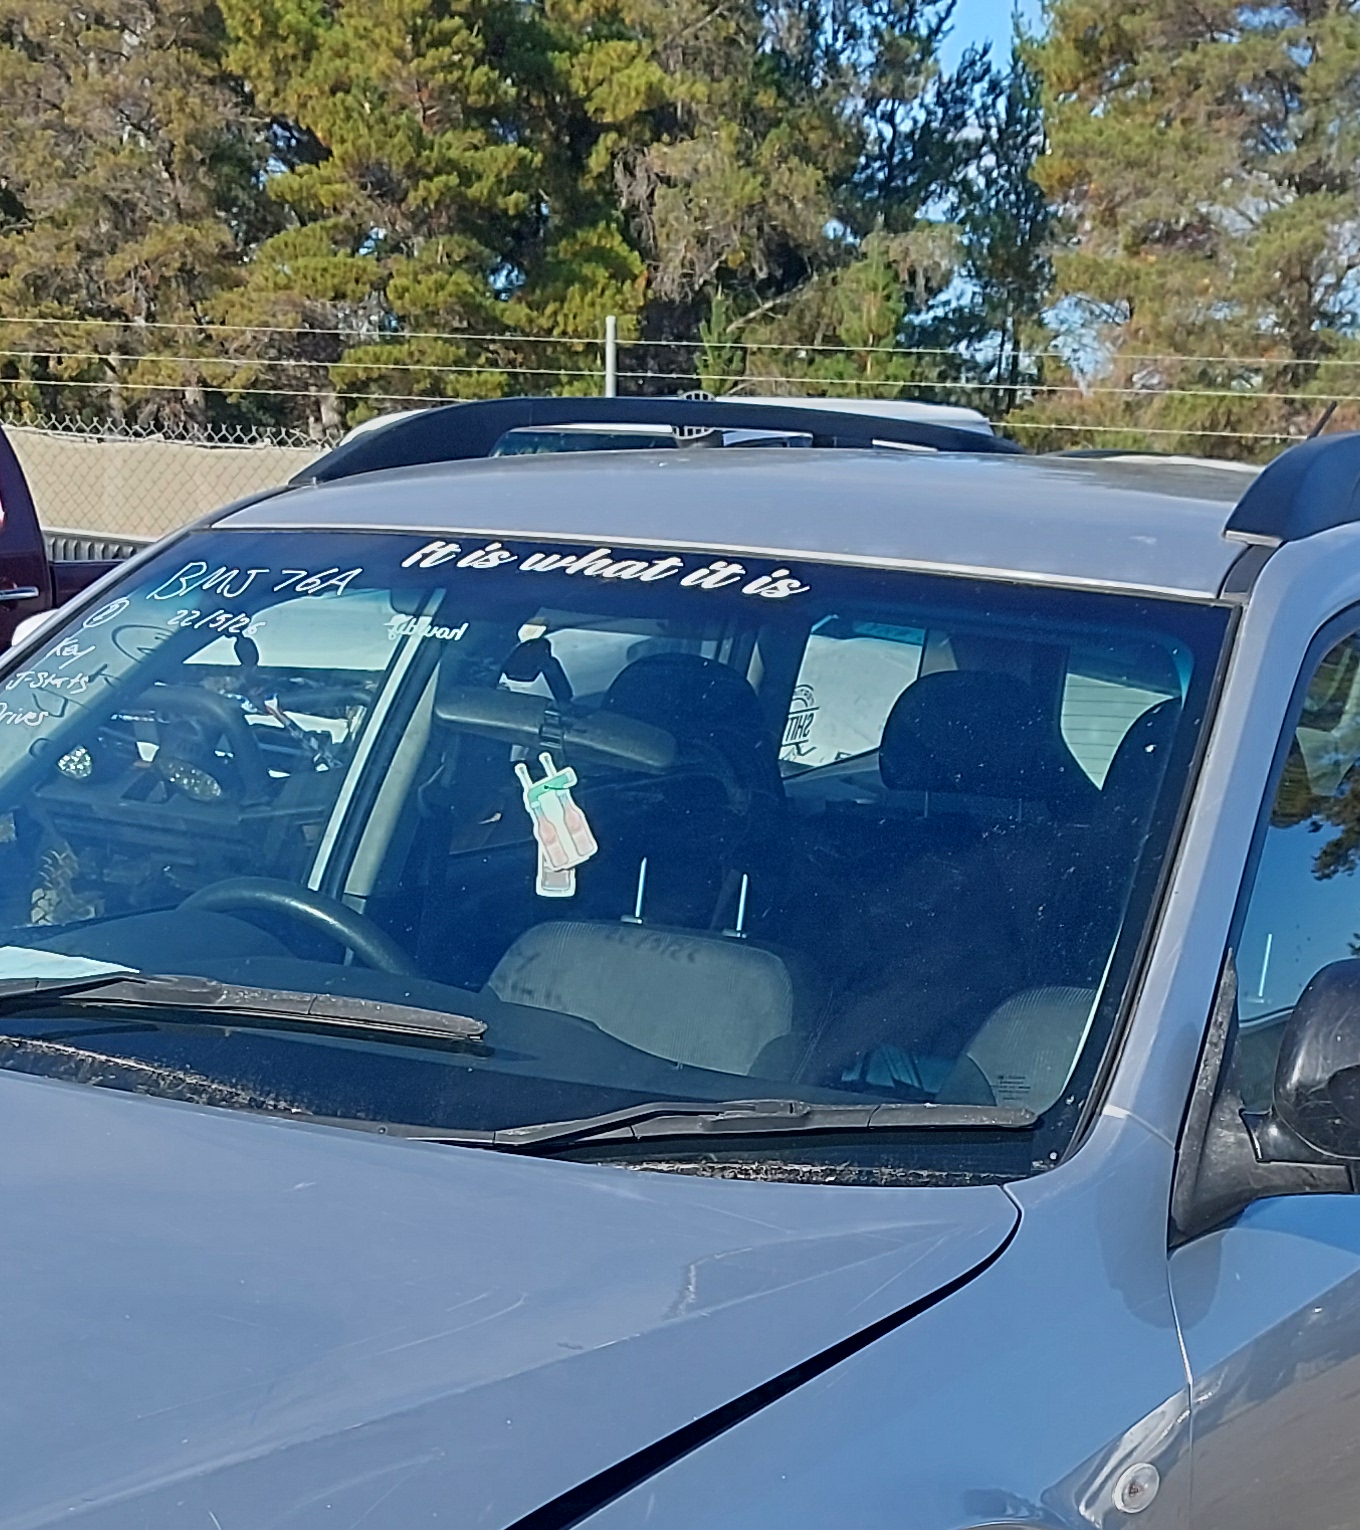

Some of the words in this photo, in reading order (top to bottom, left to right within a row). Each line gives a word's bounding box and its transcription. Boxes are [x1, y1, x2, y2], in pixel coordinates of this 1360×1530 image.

[401, 540, 462, 569] It
[456, 541, 518, 570] is
[518, 547, 684, 584] what
[679, 559, 746, 591] it
[742, 569, 810, 598] is
